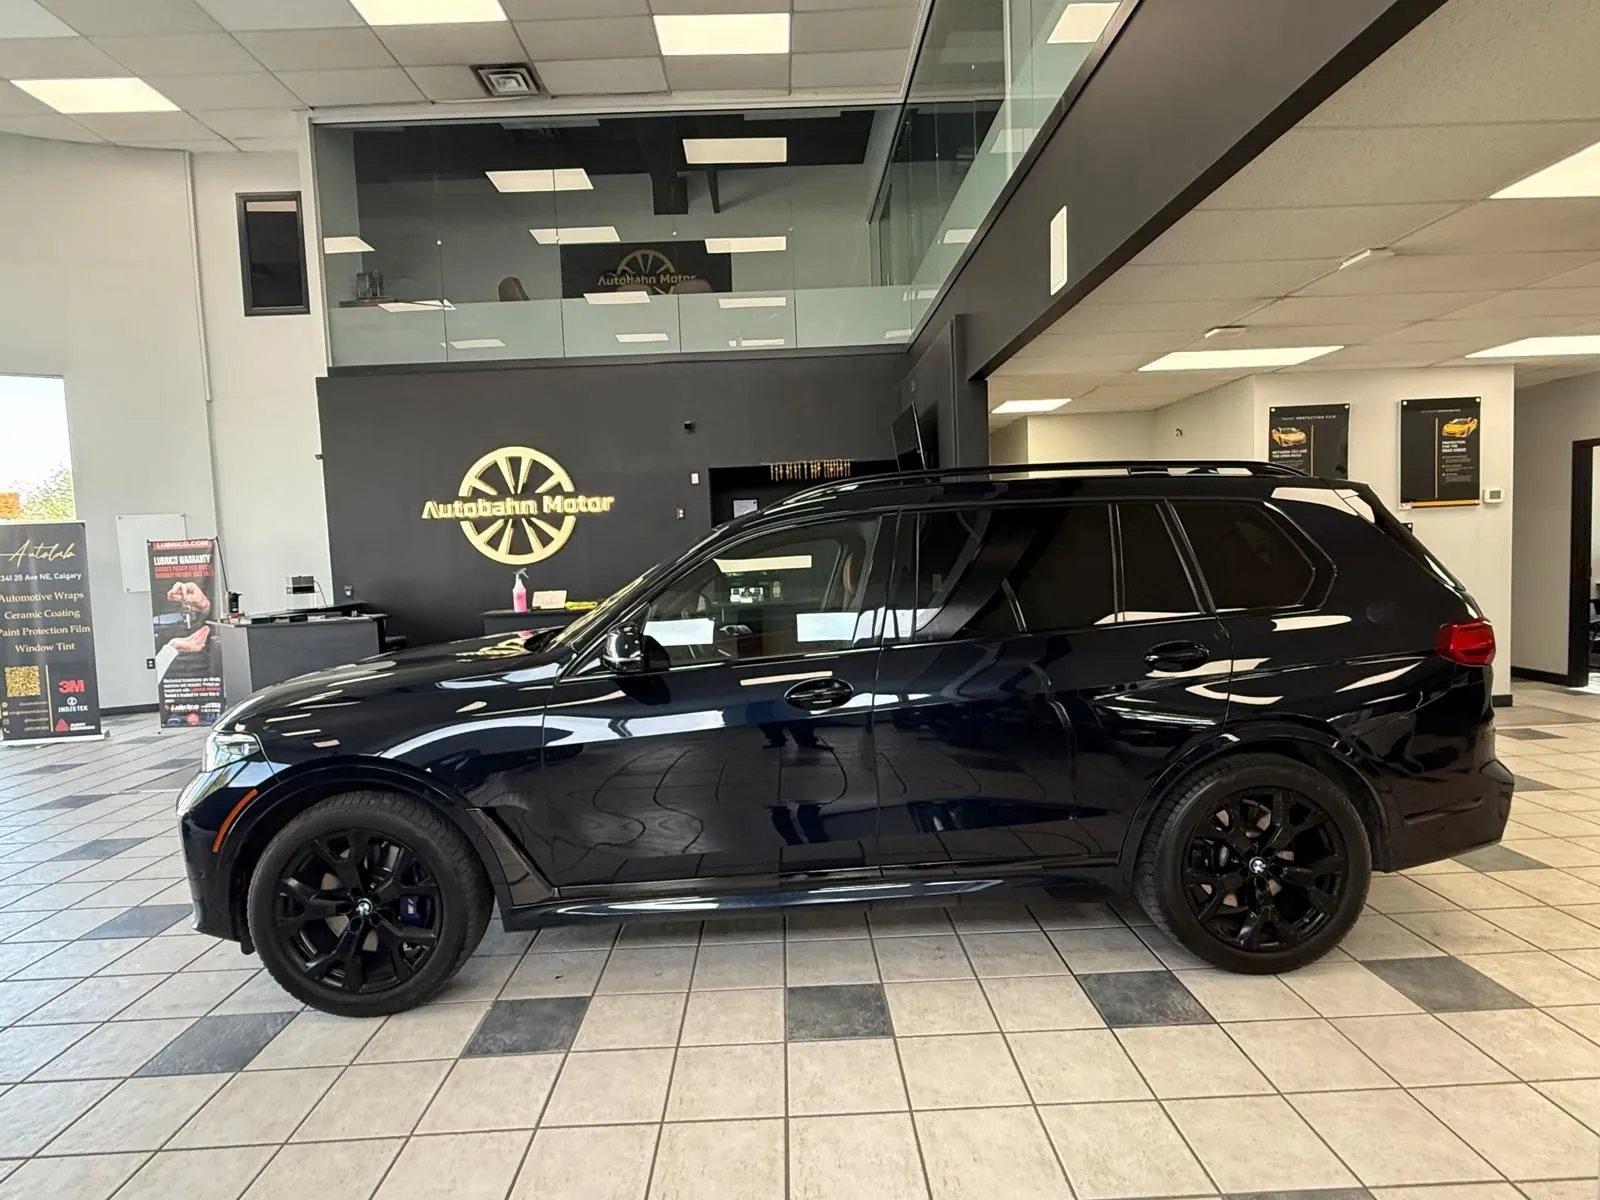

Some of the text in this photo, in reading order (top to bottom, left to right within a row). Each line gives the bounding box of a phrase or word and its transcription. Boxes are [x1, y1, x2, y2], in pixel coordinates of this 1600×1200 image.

[421, 495, 615, 519] Autobahn Motor
[153, 554, 212, 565] LUBRICO WARRANTY
[25, 573, 38, 581] Ave
[54, 572, 82, 581] Calgary
[54, 591, 84, 602] Wraps
[4, 609, 81, 620] Ceramic Coating
[22, 625, 68, 636] Protection
[70, 624, 91, 634] Film
[15, 642, 75, 653] Window Tint
[58, 679, 85, 693] 3M
